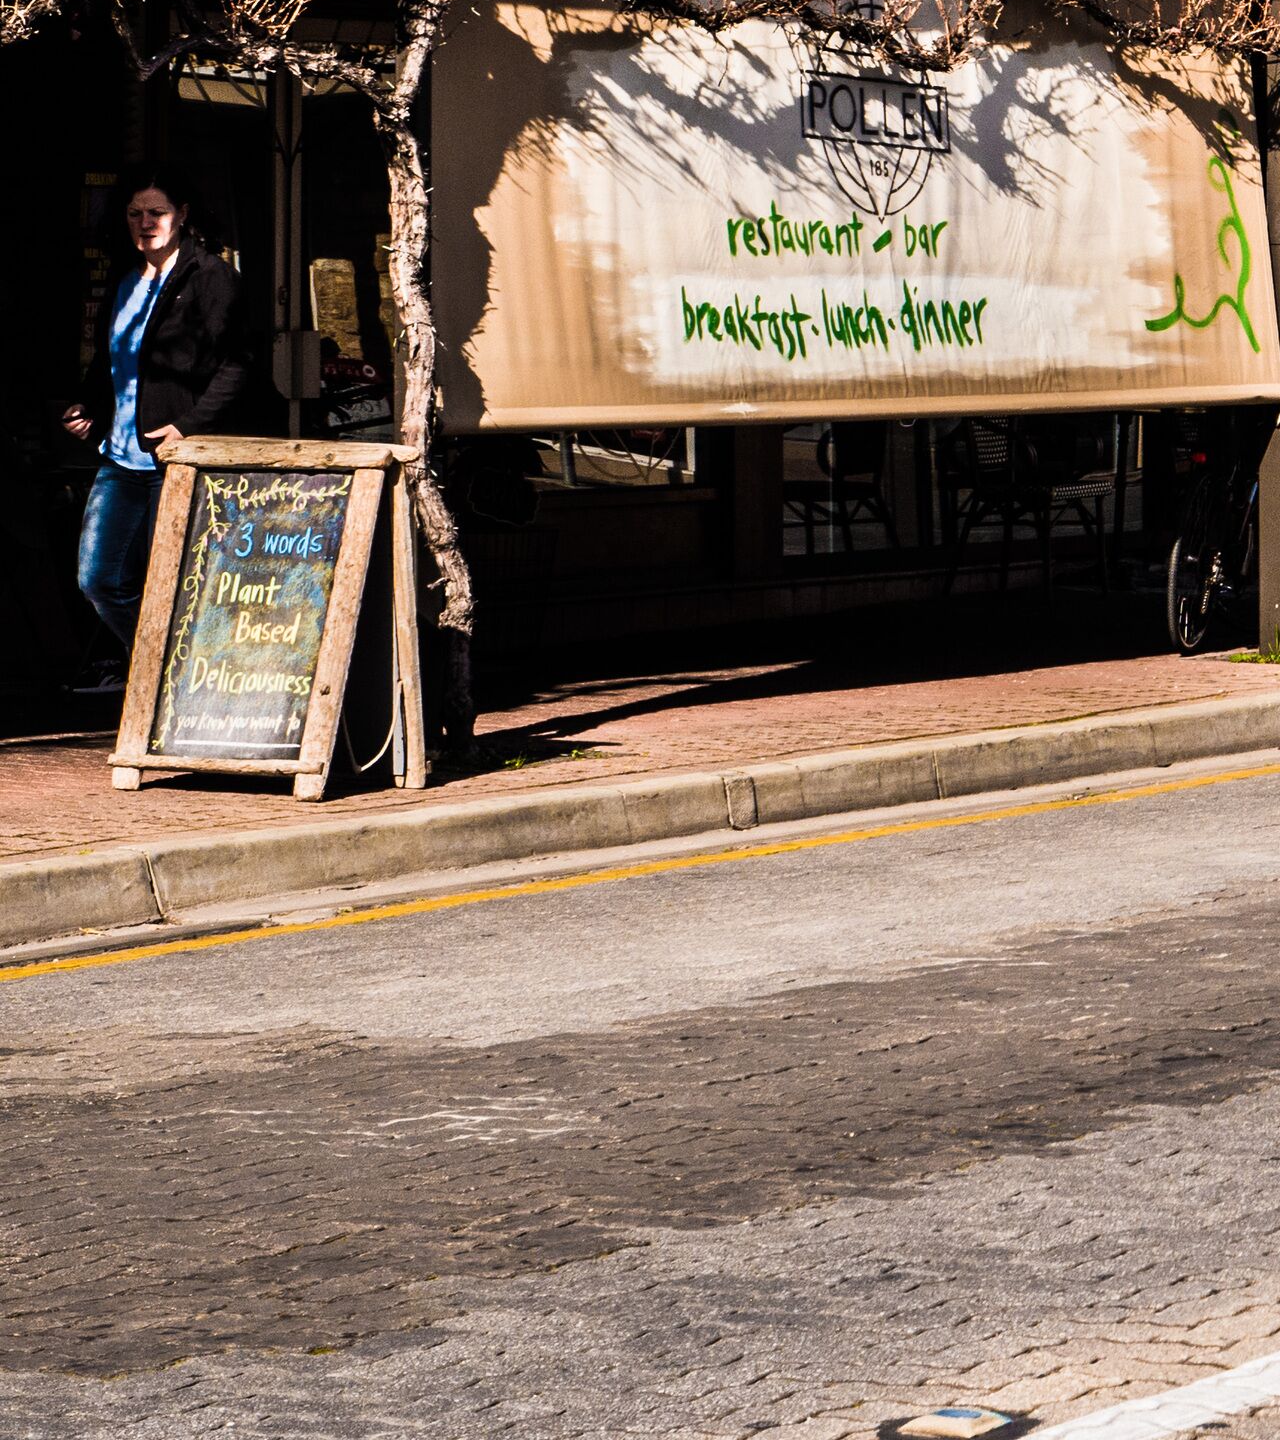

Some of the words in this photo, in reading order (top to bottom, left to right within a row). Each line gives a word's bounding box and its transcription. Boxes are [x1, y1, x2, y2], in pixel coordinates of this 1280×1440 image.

[808, 79, 944, 144] POLLEN
[870, 159, 889, 177] 185
[726, 199, 864, 257] restaurant
[903, 213, 948, 258] bar
[899, 278, 987, 353] dinner
[234, 522, 255, 558] 3
[216, 571, 282, 606] Plant
[234, 611, 301, 646] Based
[188, 656, 313, 697] Deliciousness
[174, 715, 198, 736] you
[286, 711, 301, 737] to
